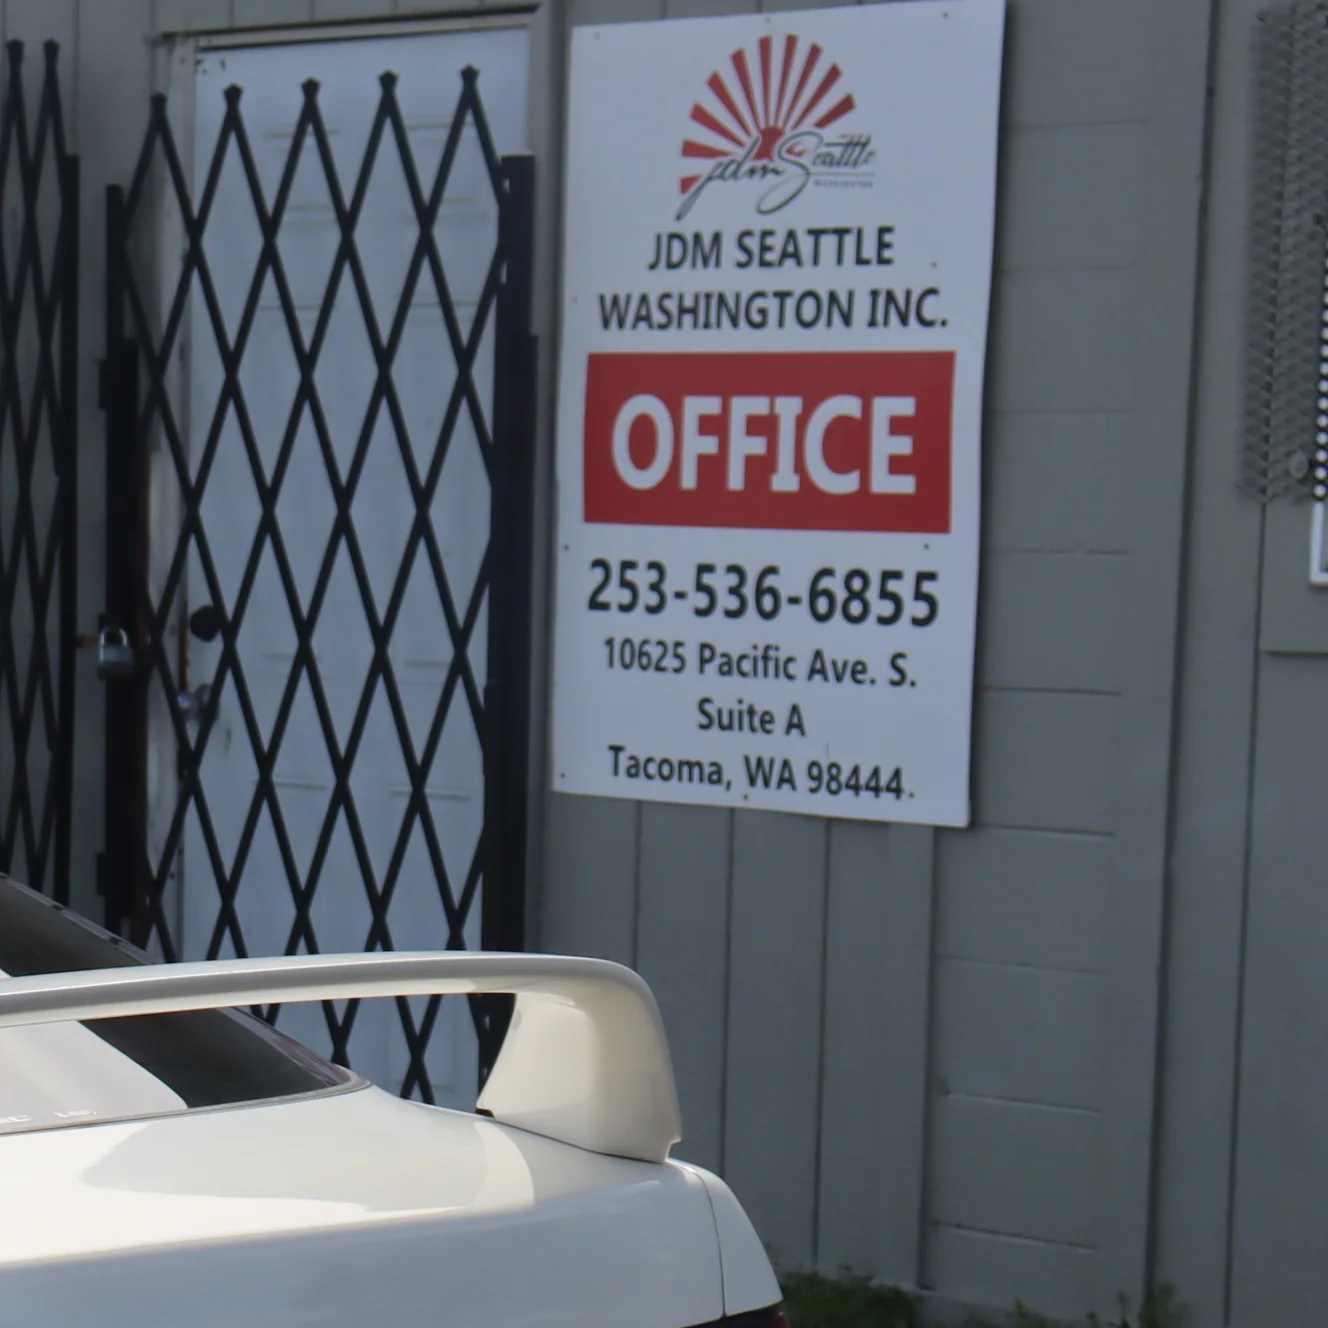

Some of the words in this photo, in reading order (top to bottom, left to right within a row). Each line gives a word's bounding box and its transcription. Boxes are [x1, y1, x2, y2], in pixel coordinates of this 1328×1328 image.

[647, 230, 723, 271] JDM
[735, 225, 895, 270] SEATTLE
[598, 289, 855, 331] WASHINGTON
[866, 286, 949, 329] INC.
[611, 394, 918, 495] OFFICE
[587, 557, 940, 628] 253-536-6855
[603, 636, 687, 675] 10625
[698, 641, 798, 682] Pacific
[806, 648, 878, 686] Ave.
[887, 651, 919, 688] S.
[696, 696, 777, 735] Suite
[783, 703, 808, 737] A
[607, 744, 733, 793] Tacoma,
[743, 754, 798, 792] WA
